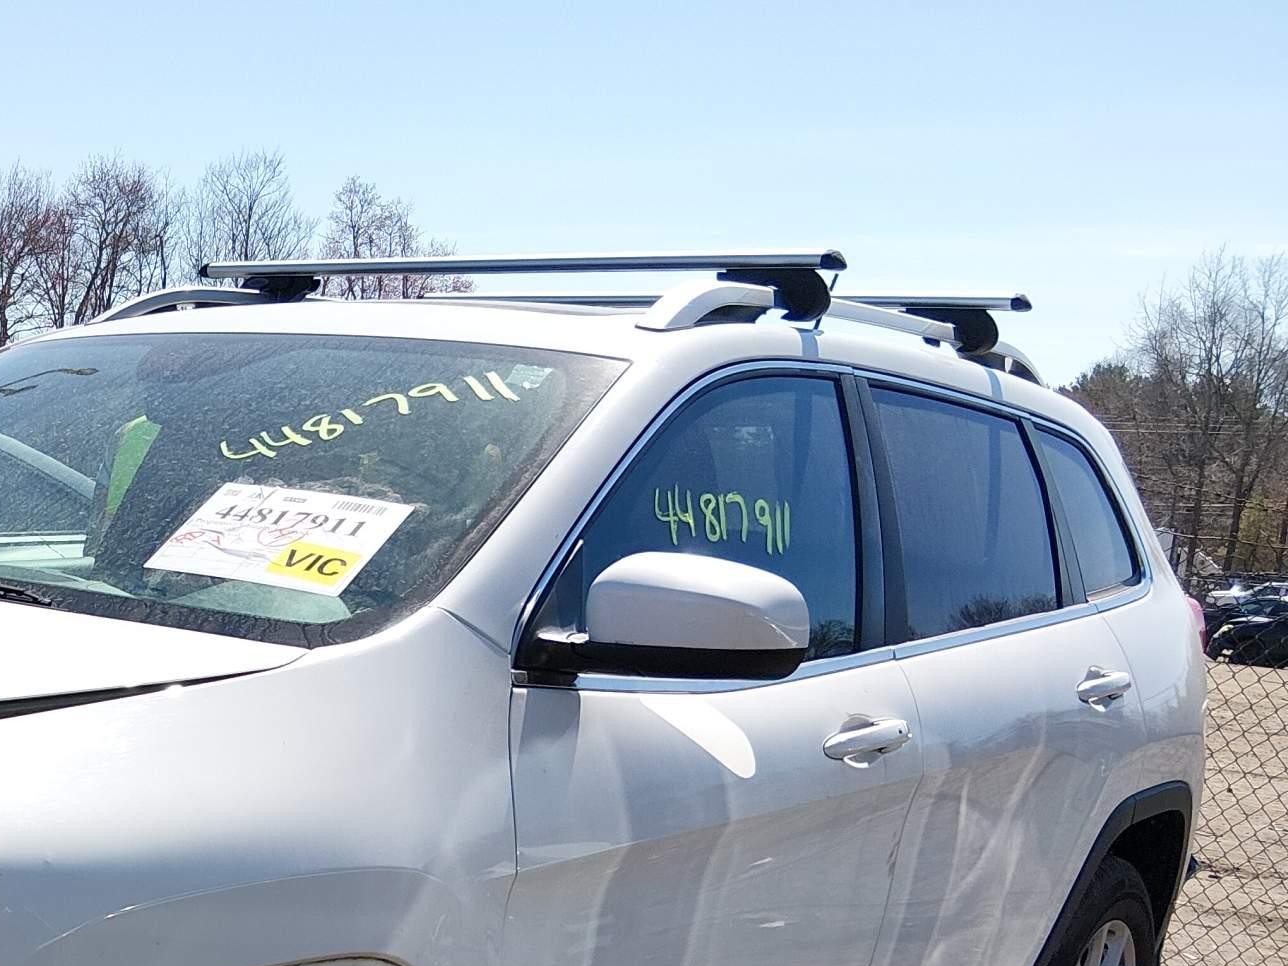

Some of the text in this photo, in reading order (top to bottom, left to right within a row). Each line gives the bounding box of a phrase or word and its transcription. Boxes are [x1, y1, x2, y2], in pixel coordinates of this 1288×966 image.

[219, 370, 521, 460] 44817911
[215, 503, 368, 538] 44817911
[654, 482, 791, 556] 44817911
[285, 548, 348, 577] VIC
